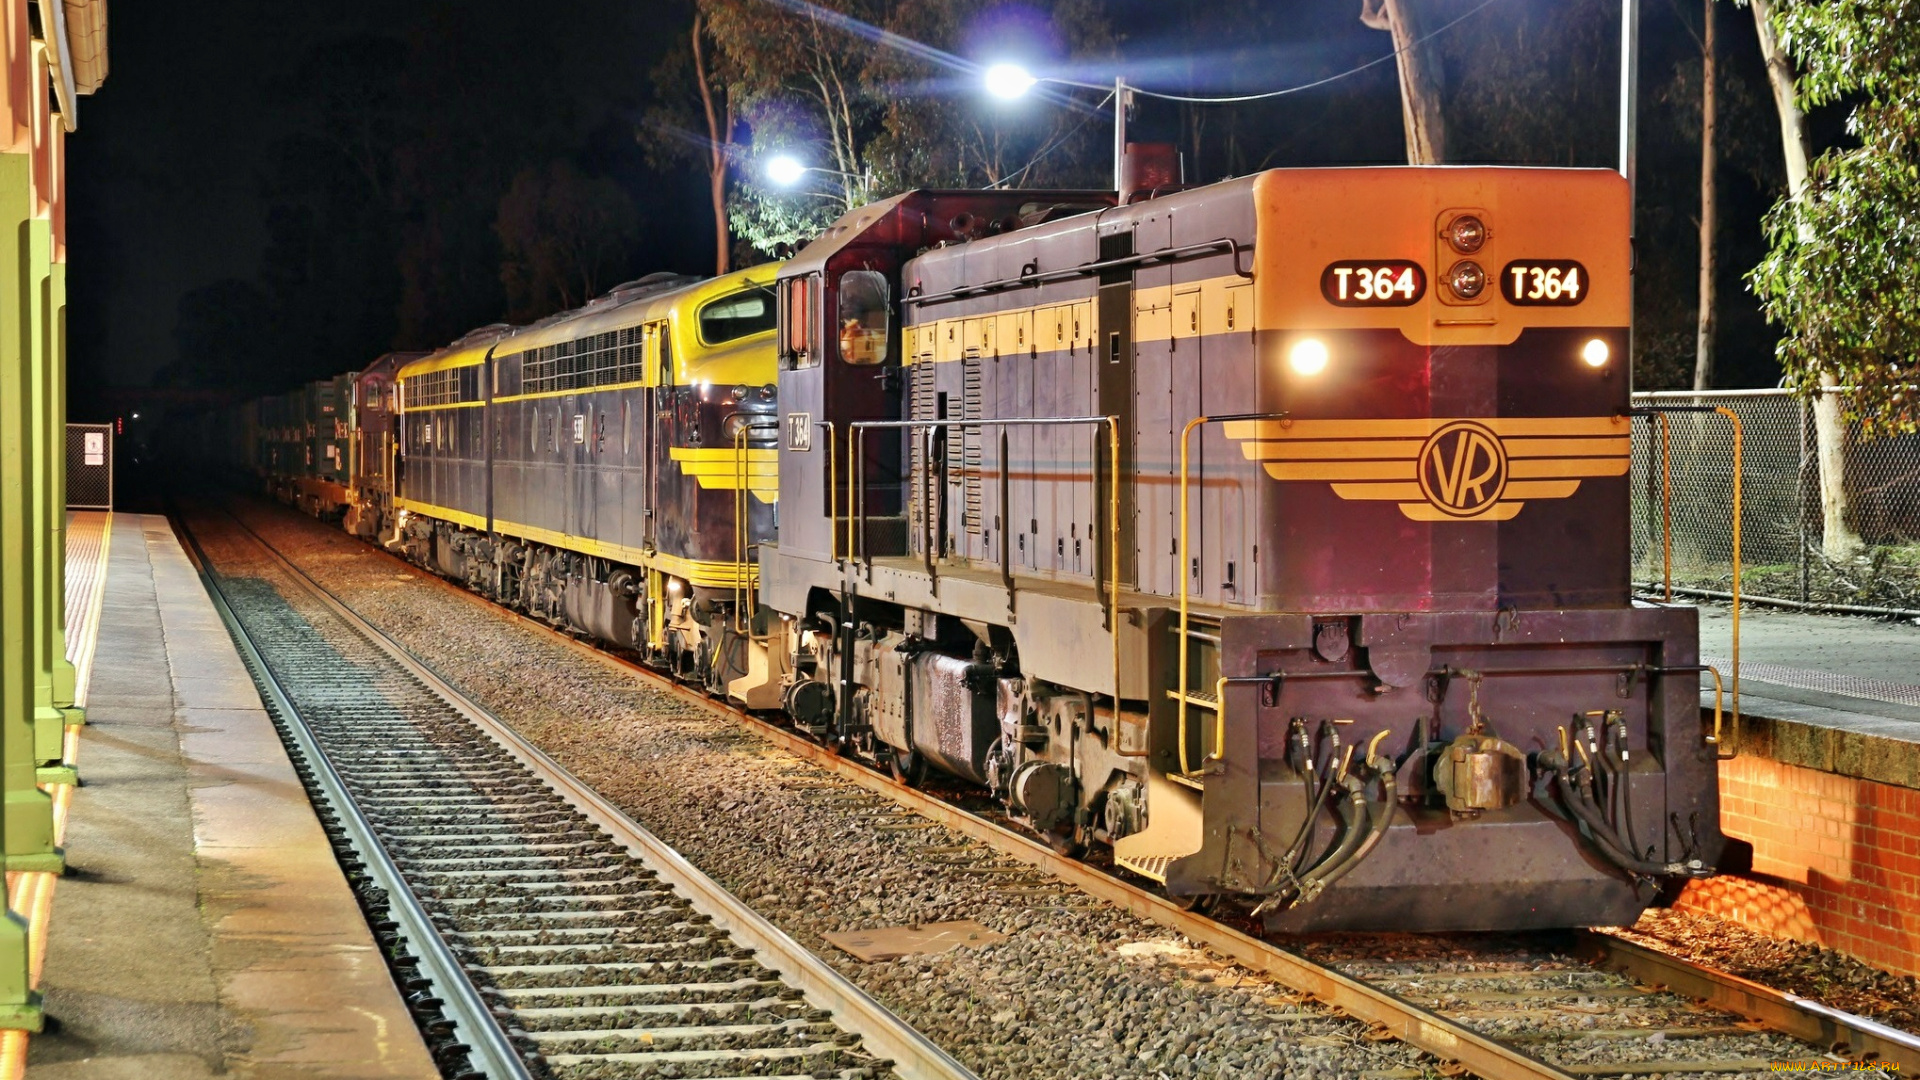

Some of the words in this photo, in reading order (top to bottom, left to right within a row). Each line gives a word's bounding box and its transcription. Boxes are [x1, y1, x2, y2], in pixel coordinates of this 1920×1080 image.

[1333, 267, 1415, 300] T364
[1511, 266, 1580, 300] T364
[1431, 430, 1499, 508] VR
